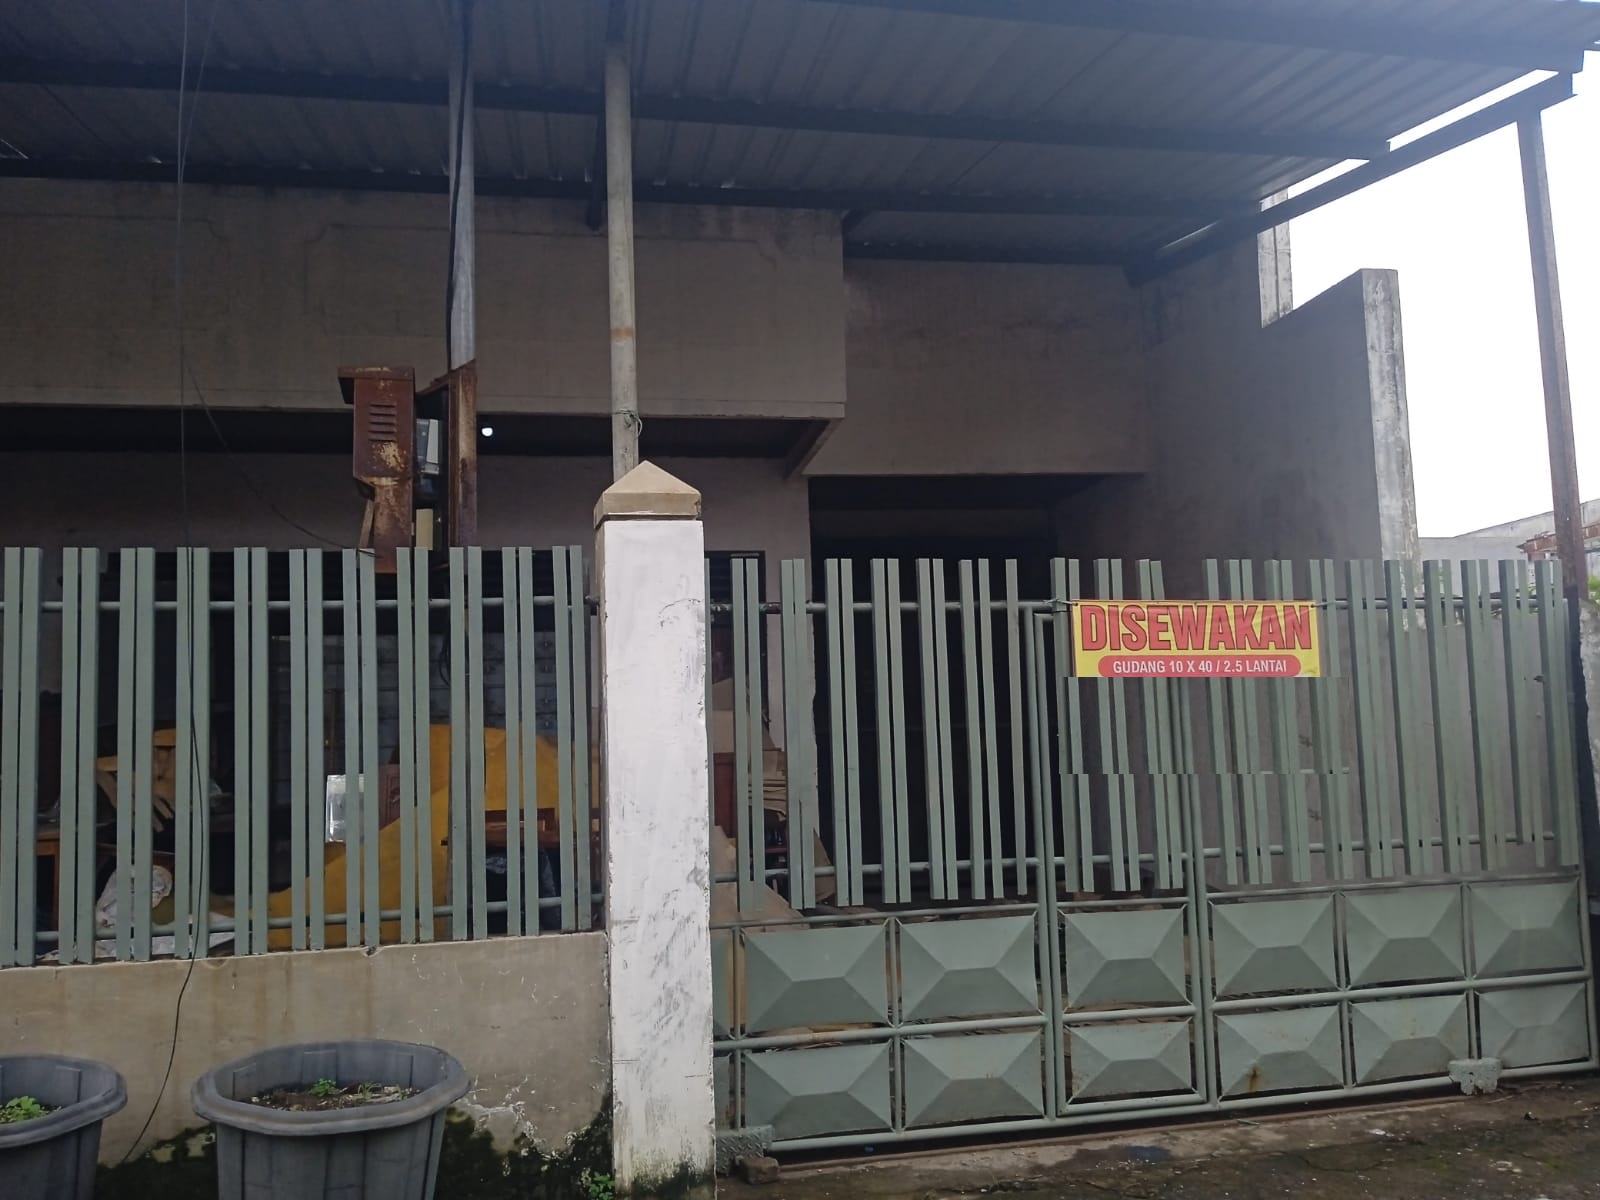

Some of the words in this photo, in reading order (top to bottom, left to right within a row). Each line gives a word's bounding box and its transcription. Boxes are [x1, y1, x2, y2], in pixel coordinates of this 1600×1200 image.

[1080, 604, 1312, 651] DISEWAKAN
[1113, 660, 1165, 673] GUDANG
[1169, 660, 1182, 673] 10
[1187, 660, 1195, 672] X
[1198, 660, 1212, 672] 40
[1215, 660, 1220, 673] /
[1224, 660, 1243, 673] 2.5
[1246, 659, 1287, 672] LANTAI
